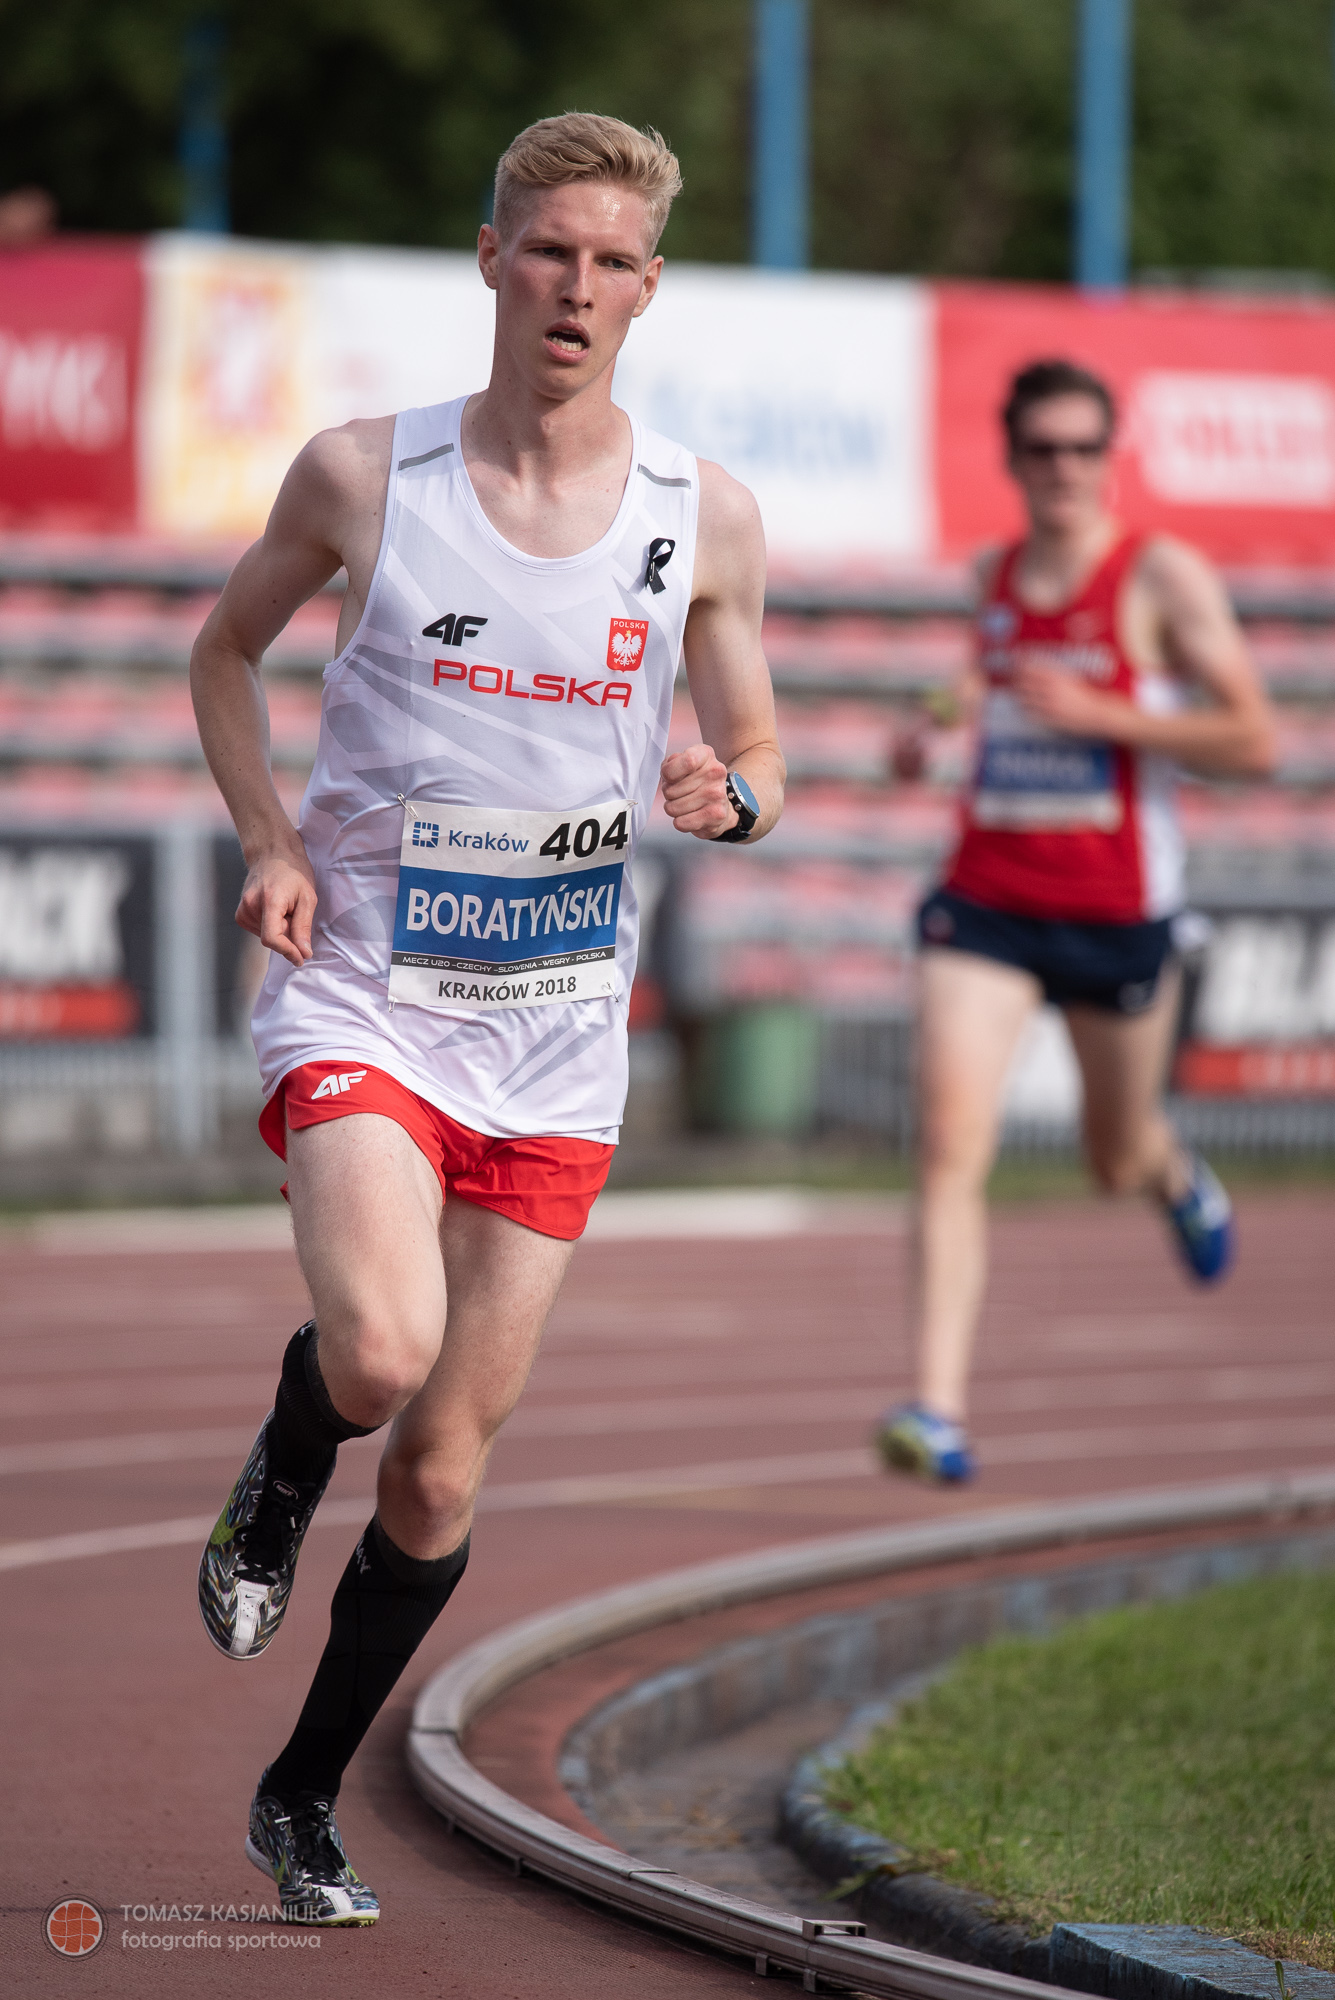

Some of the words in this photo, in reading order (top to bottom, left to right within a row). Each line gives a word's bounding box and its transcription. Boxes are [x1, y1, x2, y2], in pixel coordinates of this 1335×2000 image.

[422, 613, 488, 646] 4F
[613, 620, 646, 630] POLSKA
[433, 659, 632, 708] POLSKA
[449, 830, 529, 853] Kraków
[539, 811, 628, 861] 404
[406, 883, 615, 942] BORATYŃSKI
[402, 956, 429, 965] MECZ
[430, 959, 450, 967] U20
[576, 951, 606, 962] POLSKA
[438, 981, 529, 1001] KRAKÓW
[535, 976, 577, 997] 2018
